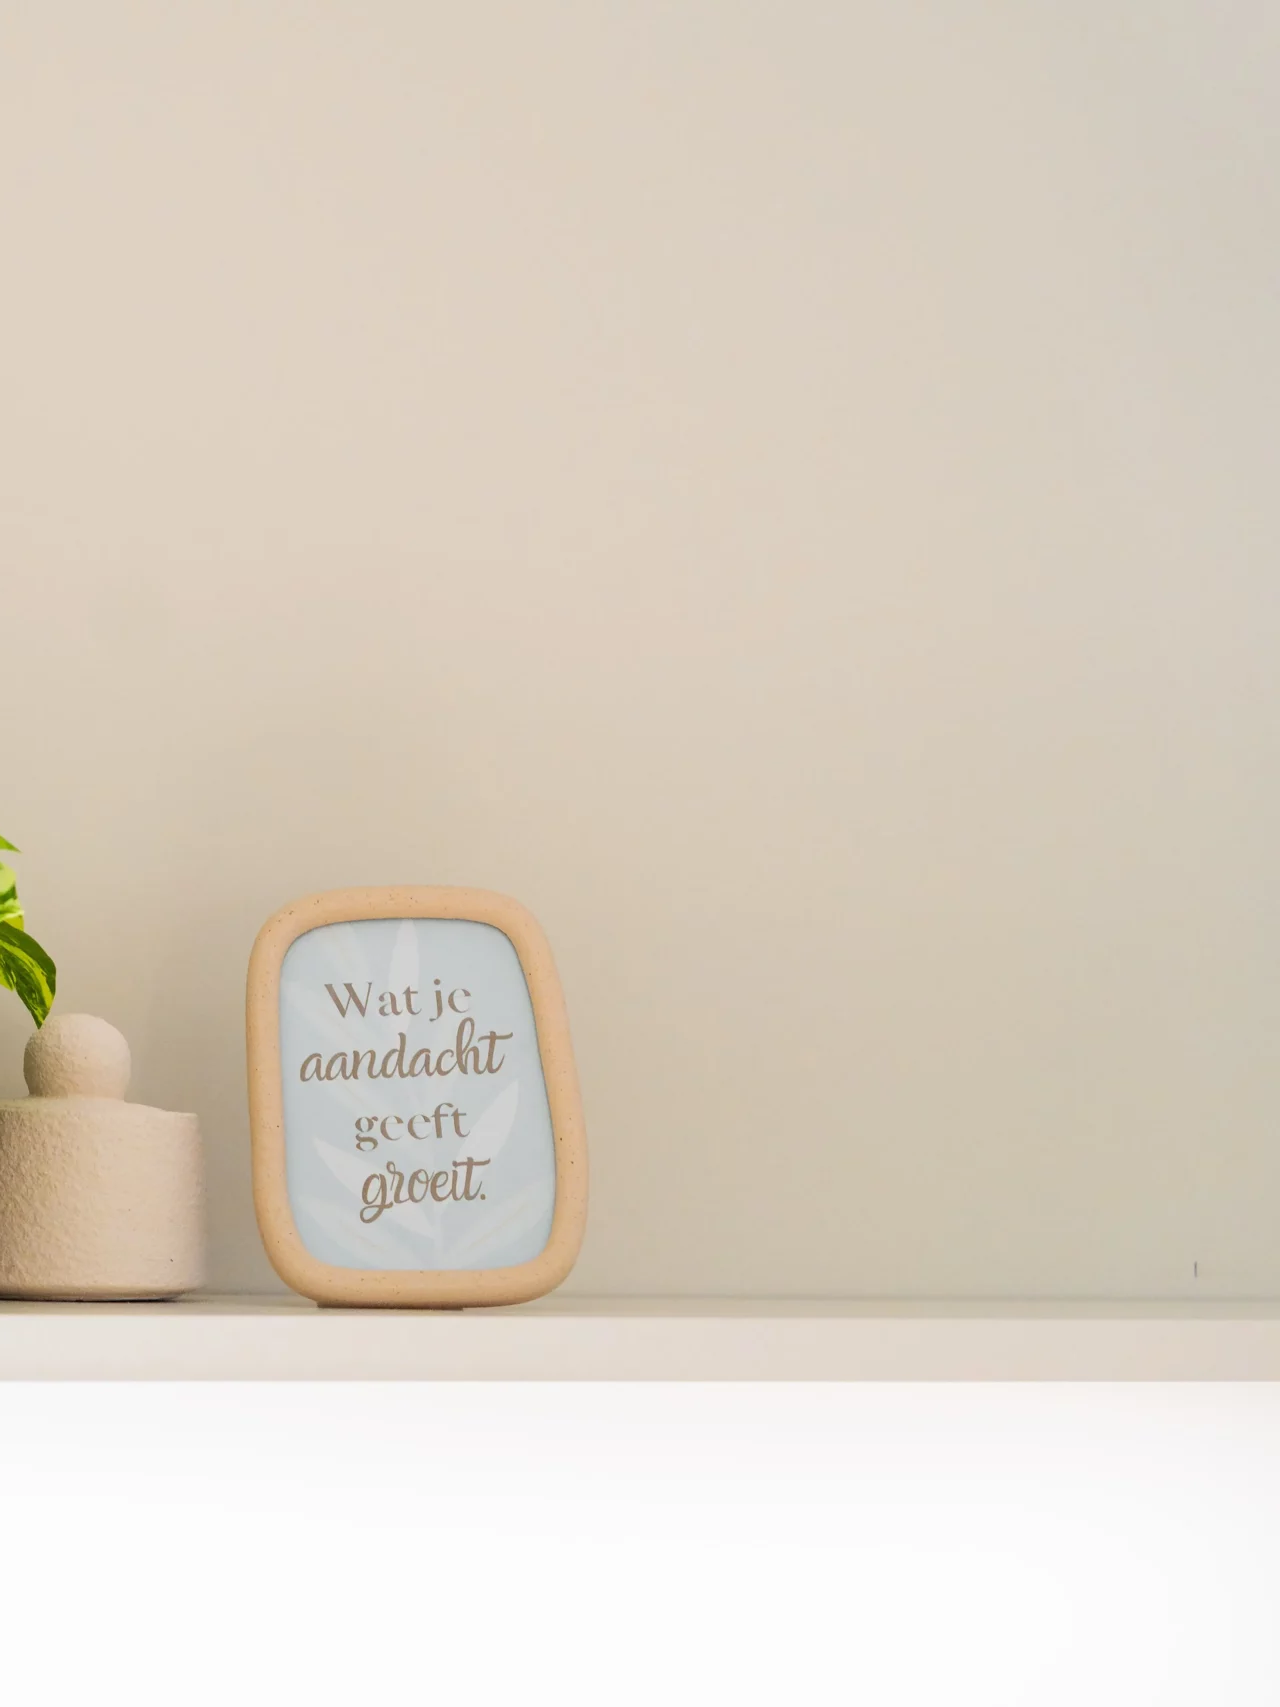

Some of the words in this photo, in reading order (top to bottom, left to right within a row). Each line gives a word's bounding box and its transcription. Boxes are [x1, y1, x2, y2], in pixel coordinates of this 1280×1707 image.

[324, 980, 422, 1018] Wat
[429, 978, 472, 1022] je
[299, 1016, 514, 1083] aandacht
[354, 1102, 470, 1152] geeft
[359, 1156, 491, 1224] groeit.
